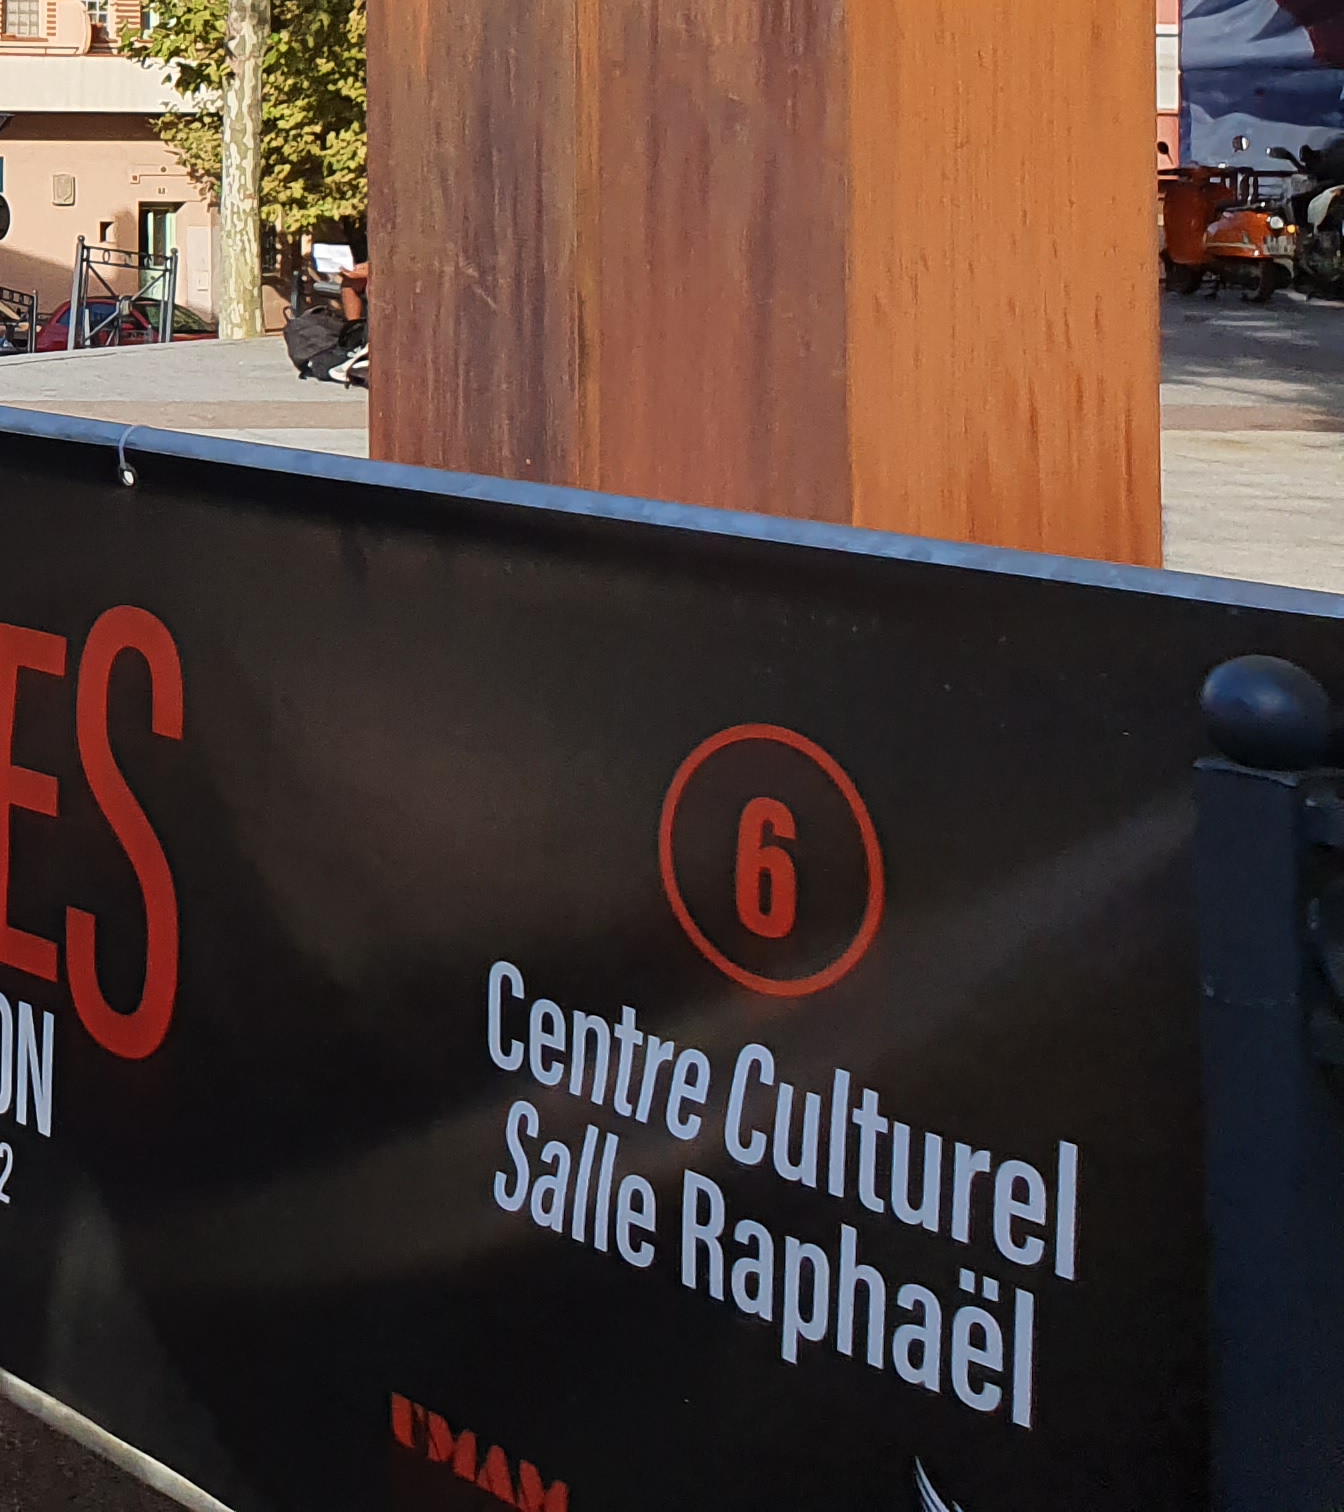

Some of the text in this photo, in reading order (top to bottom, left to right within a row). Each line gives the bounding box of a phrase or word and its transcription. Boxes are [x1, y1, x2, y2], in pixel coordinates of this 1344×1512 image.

[735, 796, 798, 939] 6
[486, 959, 1080, 1282] Centre Culturel
[494, 1100, 1036, 1430] Salle Raphaël
